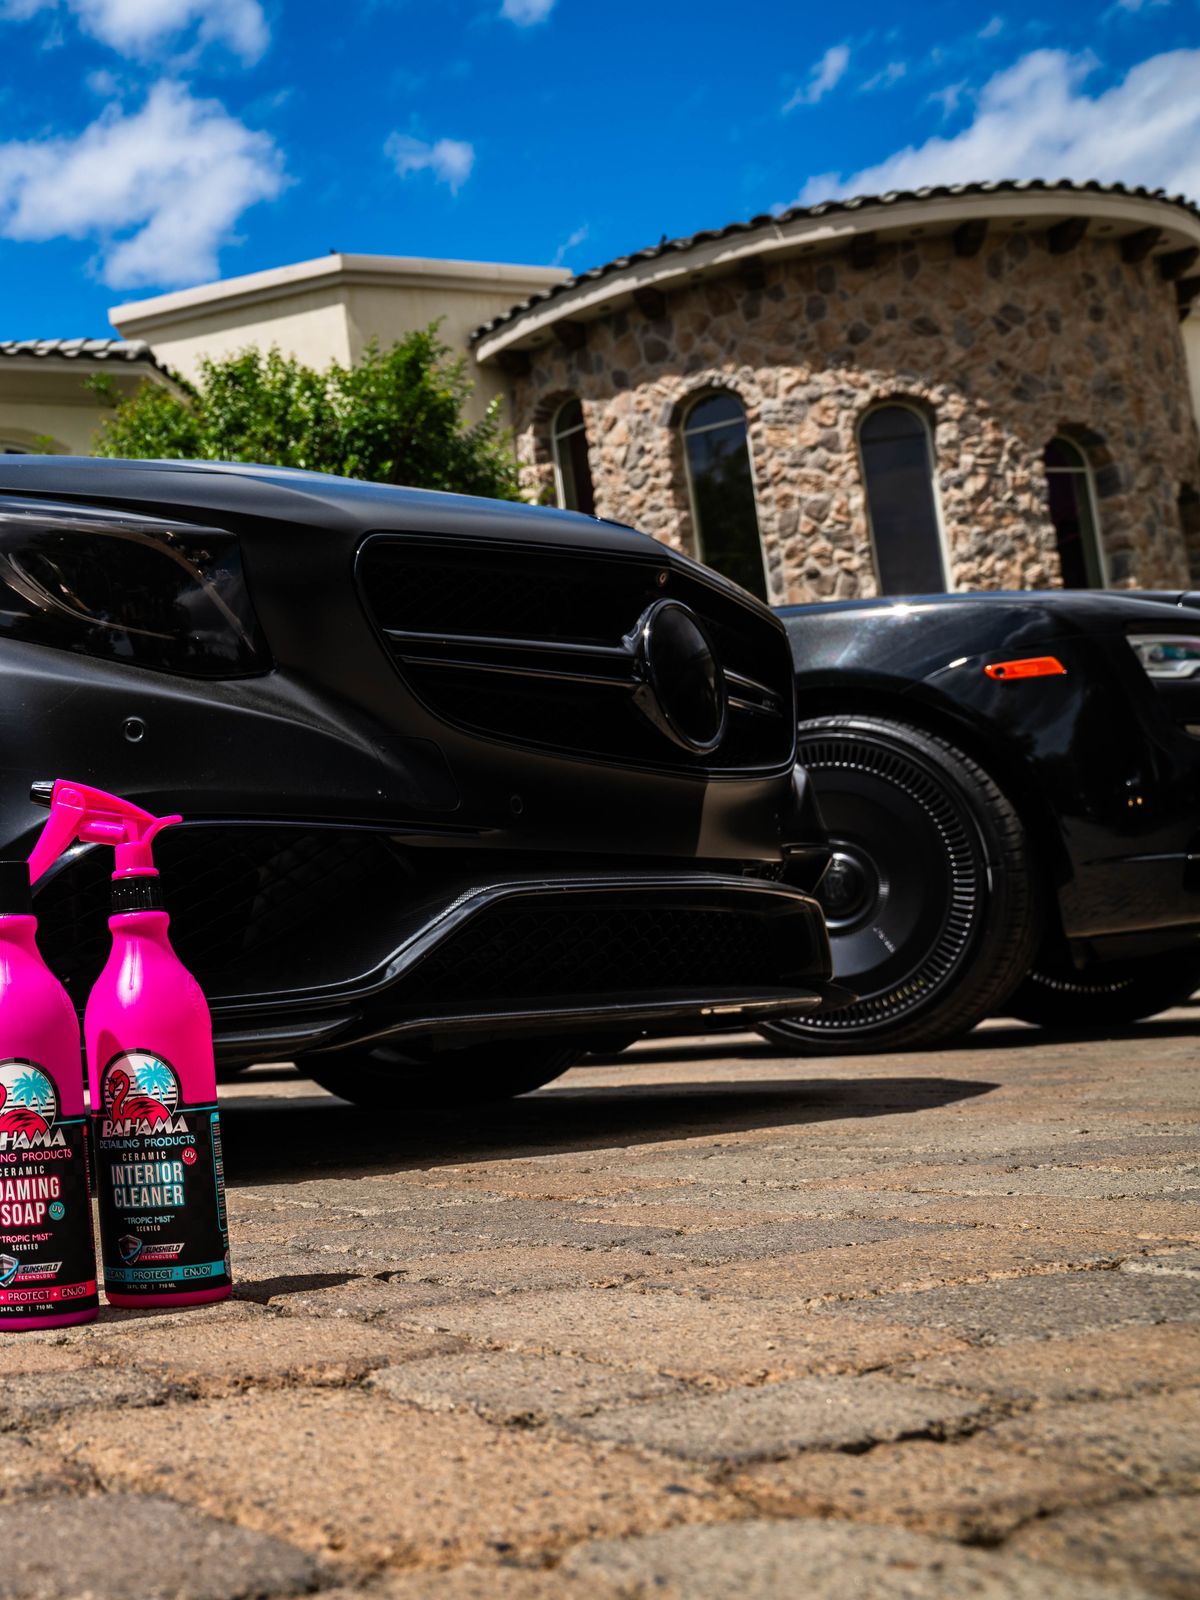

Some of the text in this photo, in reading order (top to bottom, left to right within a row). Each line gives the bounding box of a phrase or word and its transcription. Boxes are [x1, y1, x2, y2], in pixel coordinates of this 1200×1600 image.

[101, 1114, 189, 1138] BAHAMA
[99, 1135, 196, 1149] DETAILING PRODUCTS
[22, 1148, 73, 1162] PRODUCTS
[122, 1150, 167, 1162] CERAMIC
[184, 1149, 196, 1159] UV
[111, 1162, 184, 1186] INTERIOR
[114, 1185, 184, 1208] CLEANER
[0, 1202, 46, 1226] SOAP
[51, 1204, 63, 1214] UV
[22, 1263, 59, 1274] SUNSHIELD
[133, 1269, 172, 1280] PROTECT
[184, 1266, 212, 1278] ENJOY
[7, 1290, 50, 1301] PROTECT
[61, 1285, 87, 1298] ENJOY
